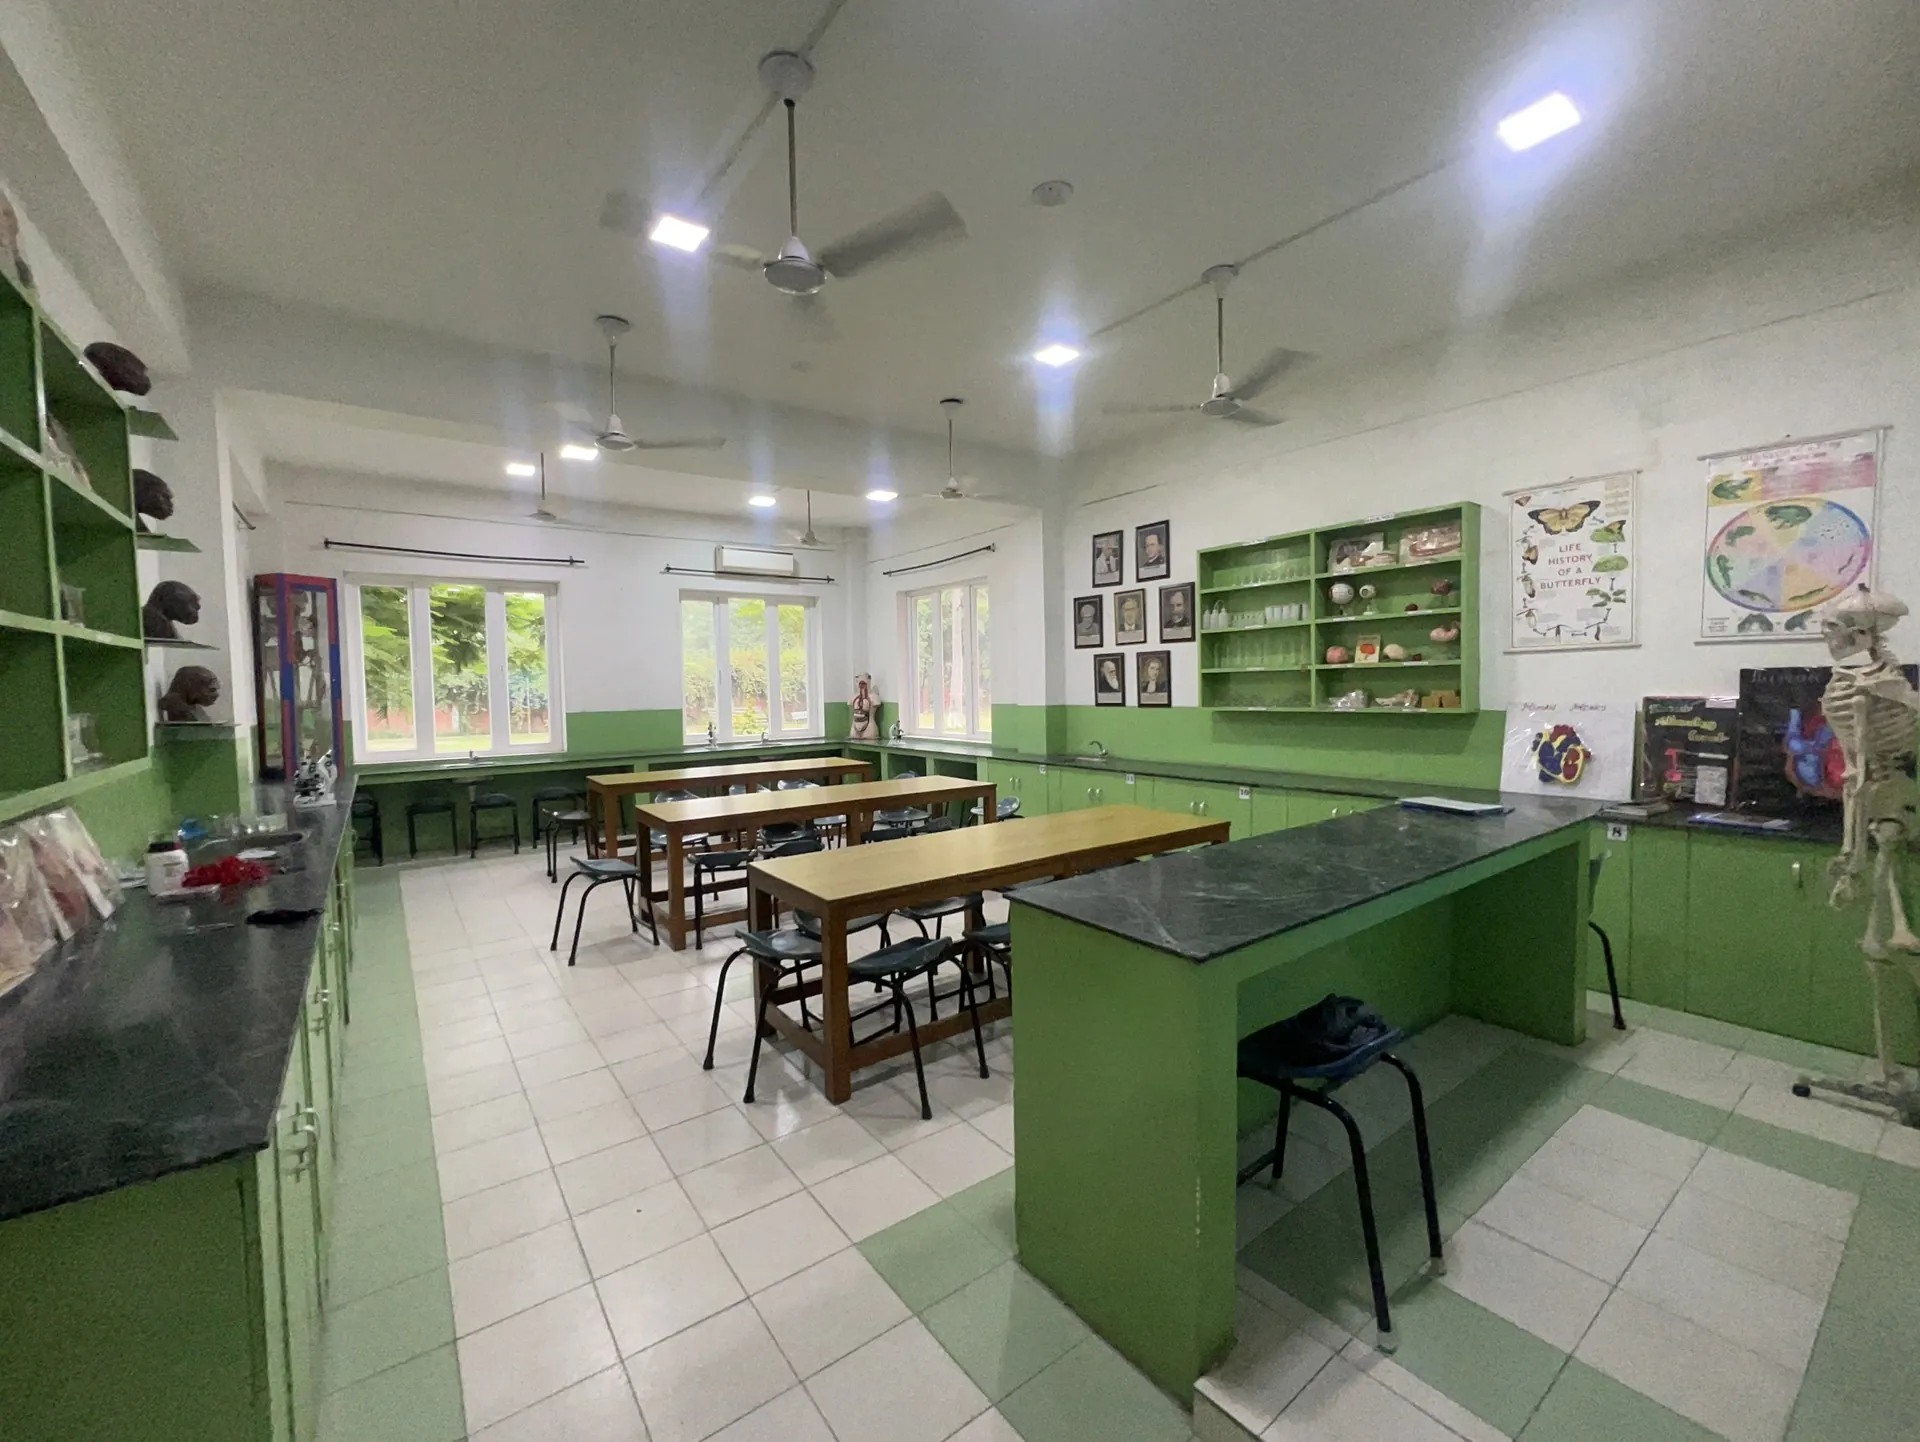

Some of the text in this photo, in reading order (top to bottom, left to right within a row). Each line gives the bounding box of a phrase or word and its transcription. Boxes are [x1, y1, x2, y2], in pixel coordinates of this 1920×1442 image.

[1559, 543, 1581, 553] LIFE
[1548, 553, 1593, 565] HISTORY
[1557, 567, 1572, 576] OF
[1540, 576, 1601, 590] BUTTERFLY
